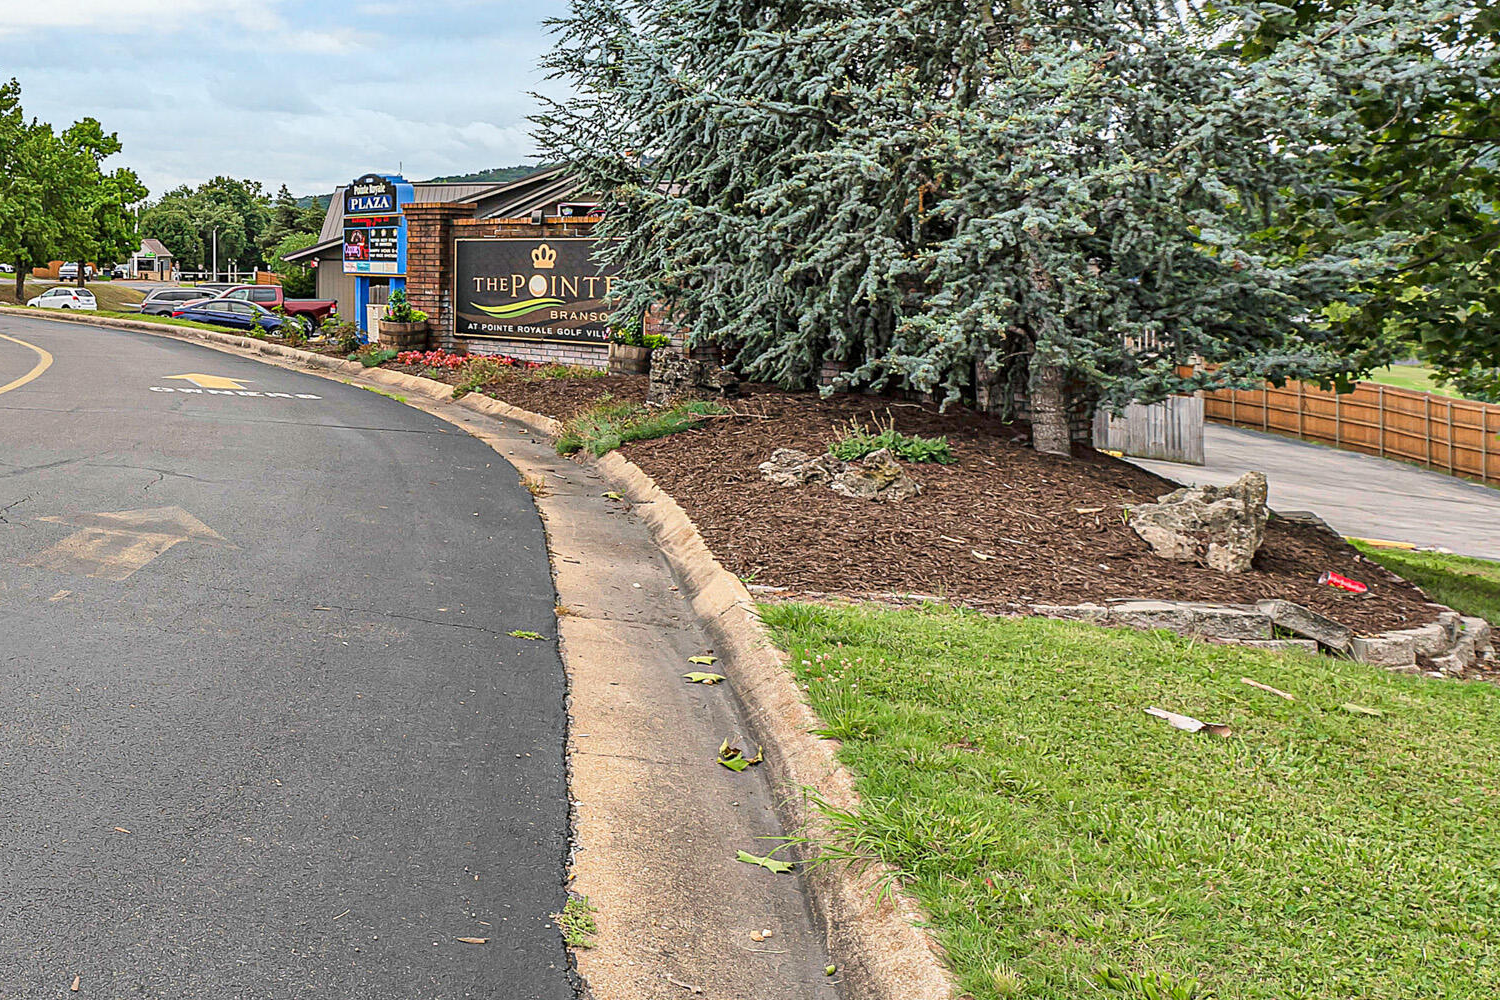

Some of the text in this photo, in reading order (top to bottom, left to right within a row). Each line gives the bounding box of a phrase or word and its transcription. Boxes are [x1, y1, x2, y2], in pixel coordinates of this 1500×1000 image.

[350, 196, 390, 211] PLAZA
[472, 276, 509, 293] THE
[549, 310, 608, 323] BRANSO
[467, 322, 479, 330] AT
[481, 323, 514, 333] POINTE
[517, 325, 553, 335] ROYALE
[556, 328, 582, 336] GOLF
